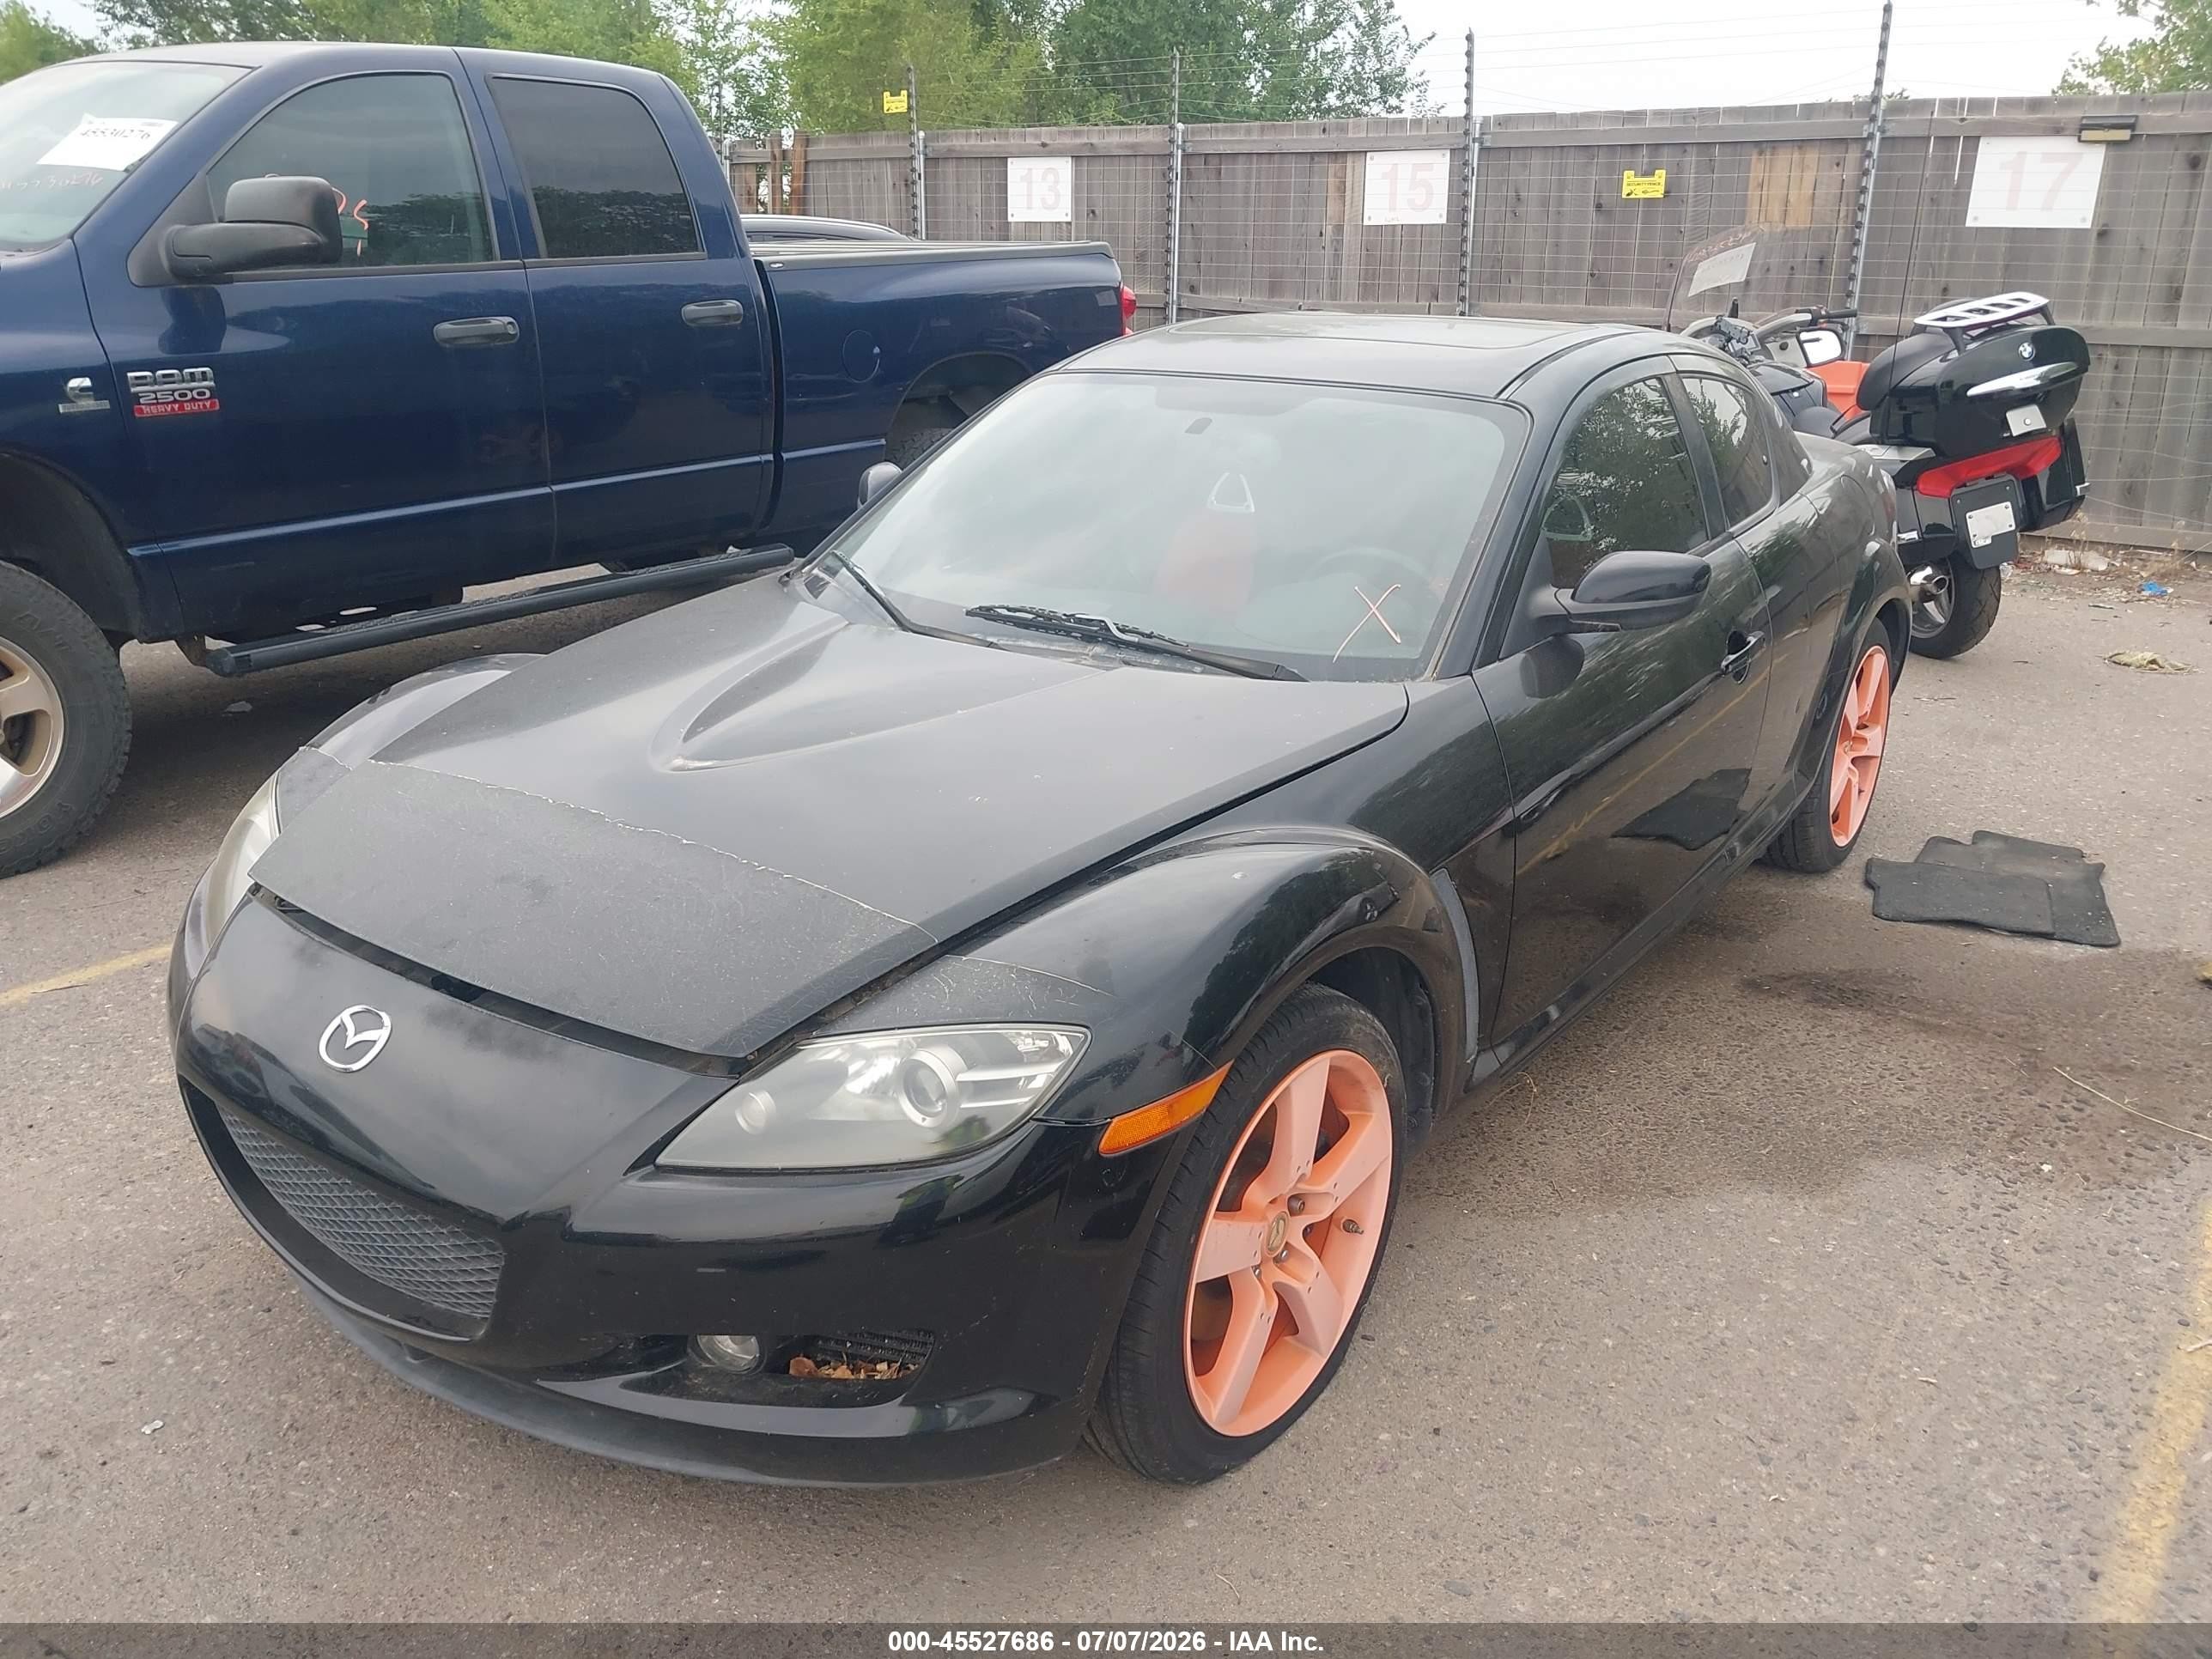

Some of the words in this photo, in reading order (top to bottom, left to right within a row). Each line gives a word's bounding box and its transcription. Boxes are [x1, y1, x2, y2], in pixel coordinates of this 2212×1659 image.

[1019, 166, 1061, 211] 13
[1381, 162, 1434, 213] 15
[1998, 150, 2084, 212] 17
[126, 367, 216, 392] RAM
[138, 388, 211, 404] 2500
[143, 404, 179, 415] HEAVY
[184, 400, 211, 412] DUTY
